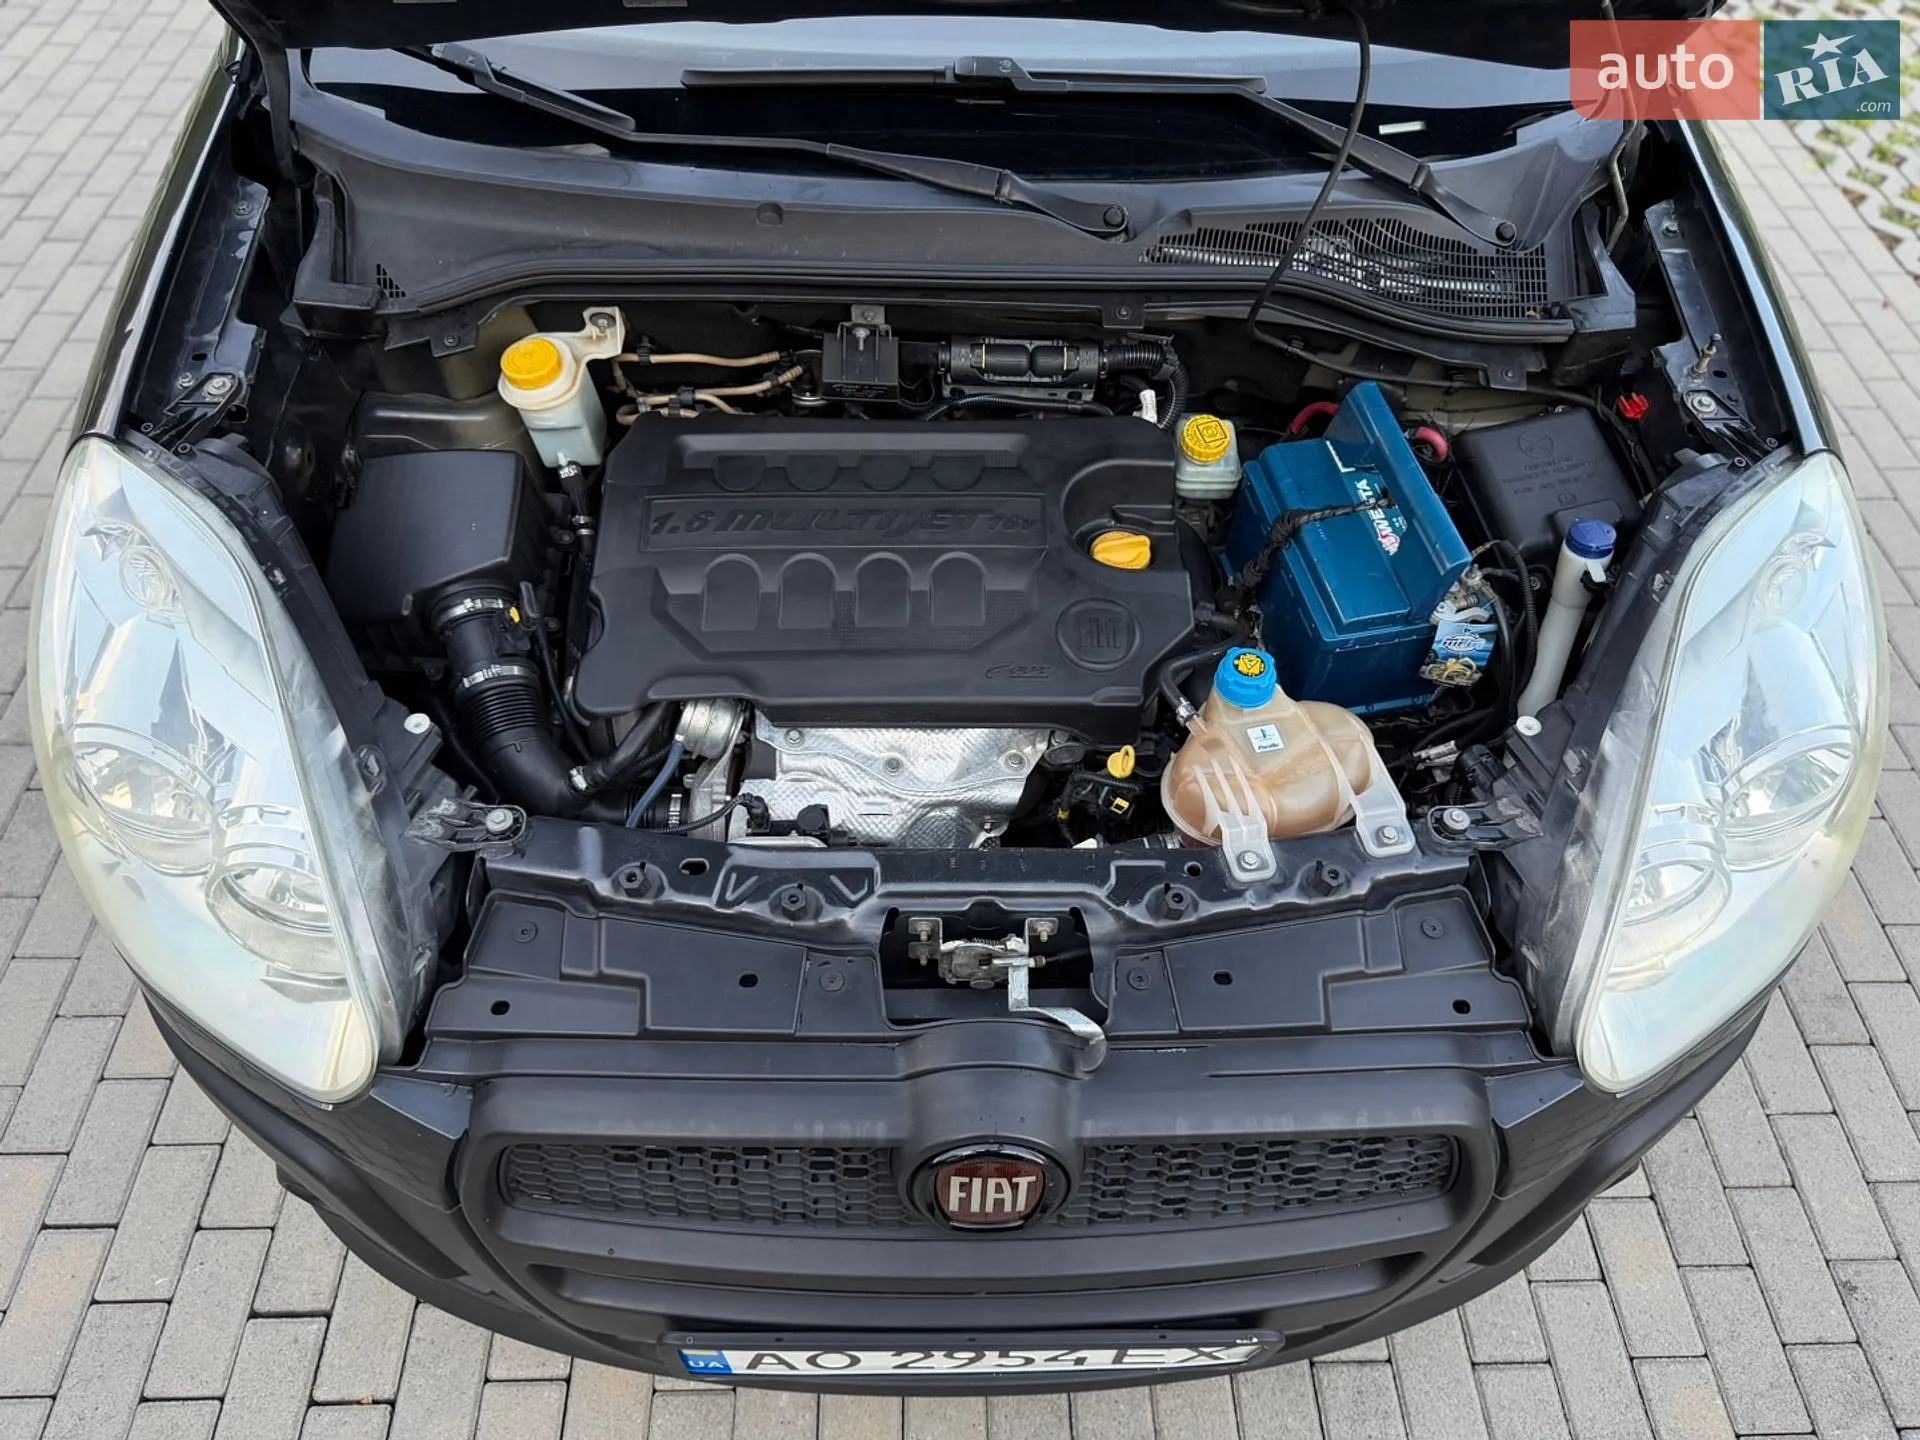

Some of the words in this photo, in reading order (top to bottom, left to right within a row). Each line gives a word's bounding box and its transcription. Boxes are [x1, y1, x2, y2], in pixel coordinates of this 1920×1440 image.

[651, 511, 716, 536] 1.6
[948, 1176, 1037, 1213] FIAT
[687, 1359, 724, 1369] UA
[745, 1350, 862, 1371] AO
[891, 1350, 1089, 1371] 2954
[1110, 1346, 1229, 1366] EX
